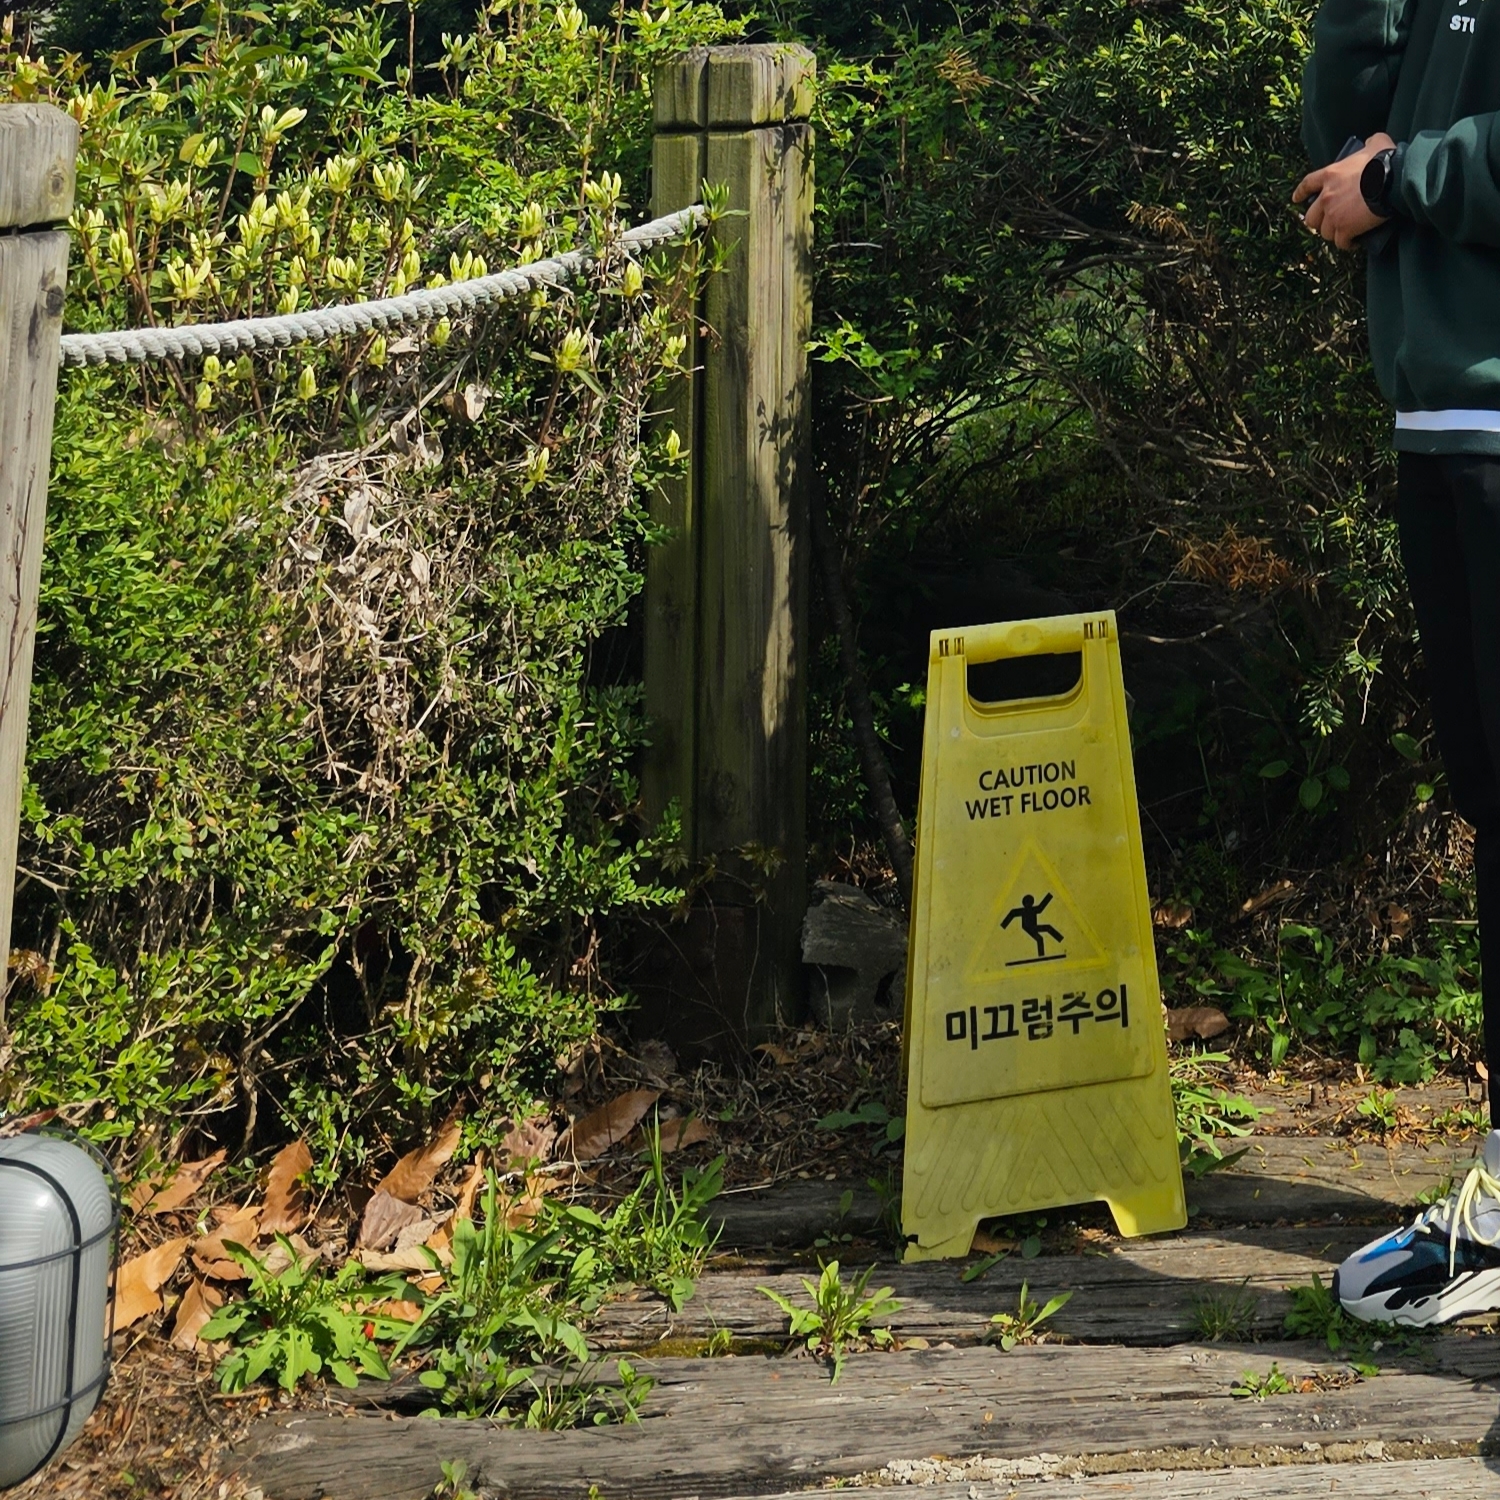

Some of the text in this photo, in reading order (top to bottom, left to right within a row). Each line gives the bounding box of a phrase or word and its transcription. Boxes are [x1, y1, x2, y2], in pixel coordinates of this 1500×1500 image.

[978, 759, 1076, 792] CAUTION
[965, 785, 1092, 821] WET FLOOR
[945, 983, 1129, 1051] 미끄럼주의
